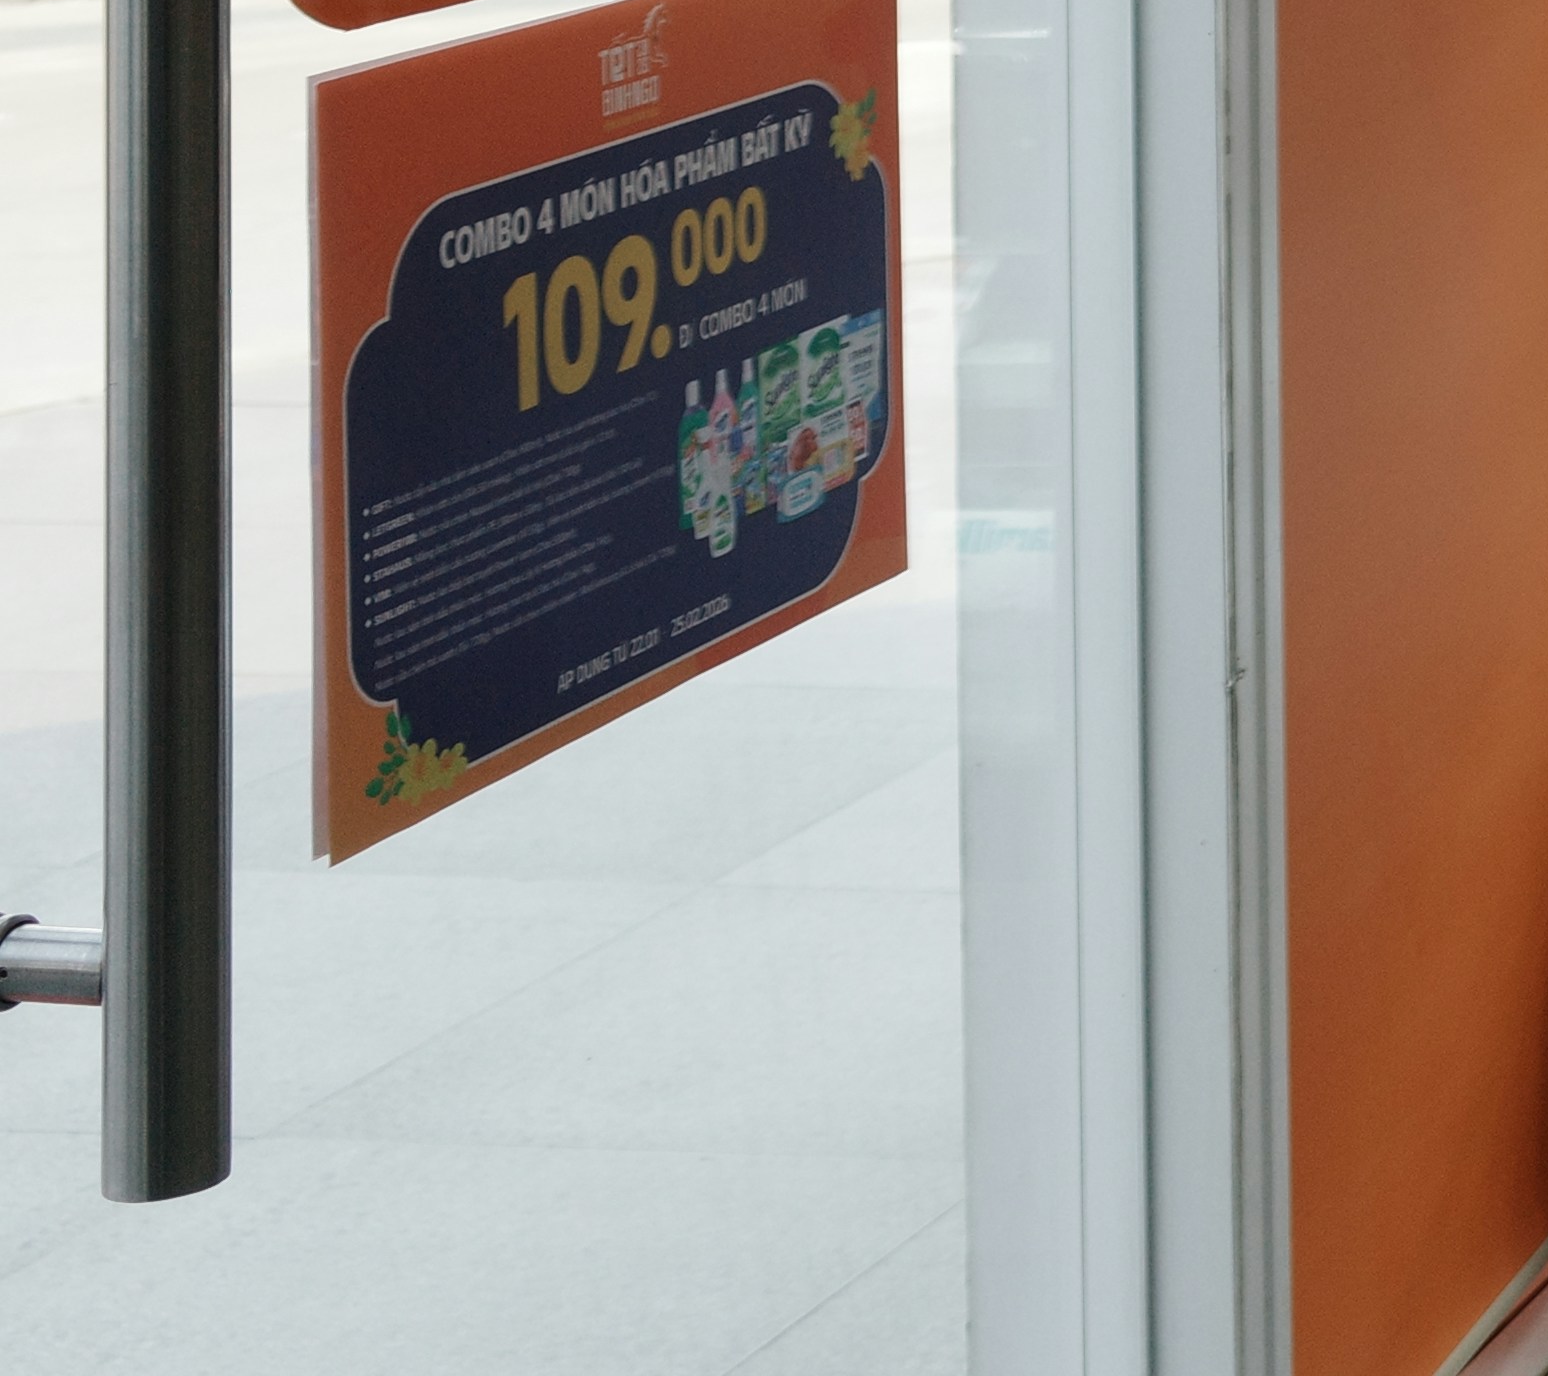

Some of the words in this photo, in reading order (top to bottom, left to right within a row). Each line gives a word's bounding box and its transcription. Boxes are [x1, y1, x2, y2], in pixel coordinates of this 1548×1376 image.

[439, 206, 530, 268] COMBO
[536, 198, 552, 234] 4
[560, 179, 615, 231] MÓN
[620, 159, 668, 206] HÓA
[674, 130, 737, 190] PHẨM
[740, 115, 780, 164] BẤT
[785, 109, 813, 154] KỲ
